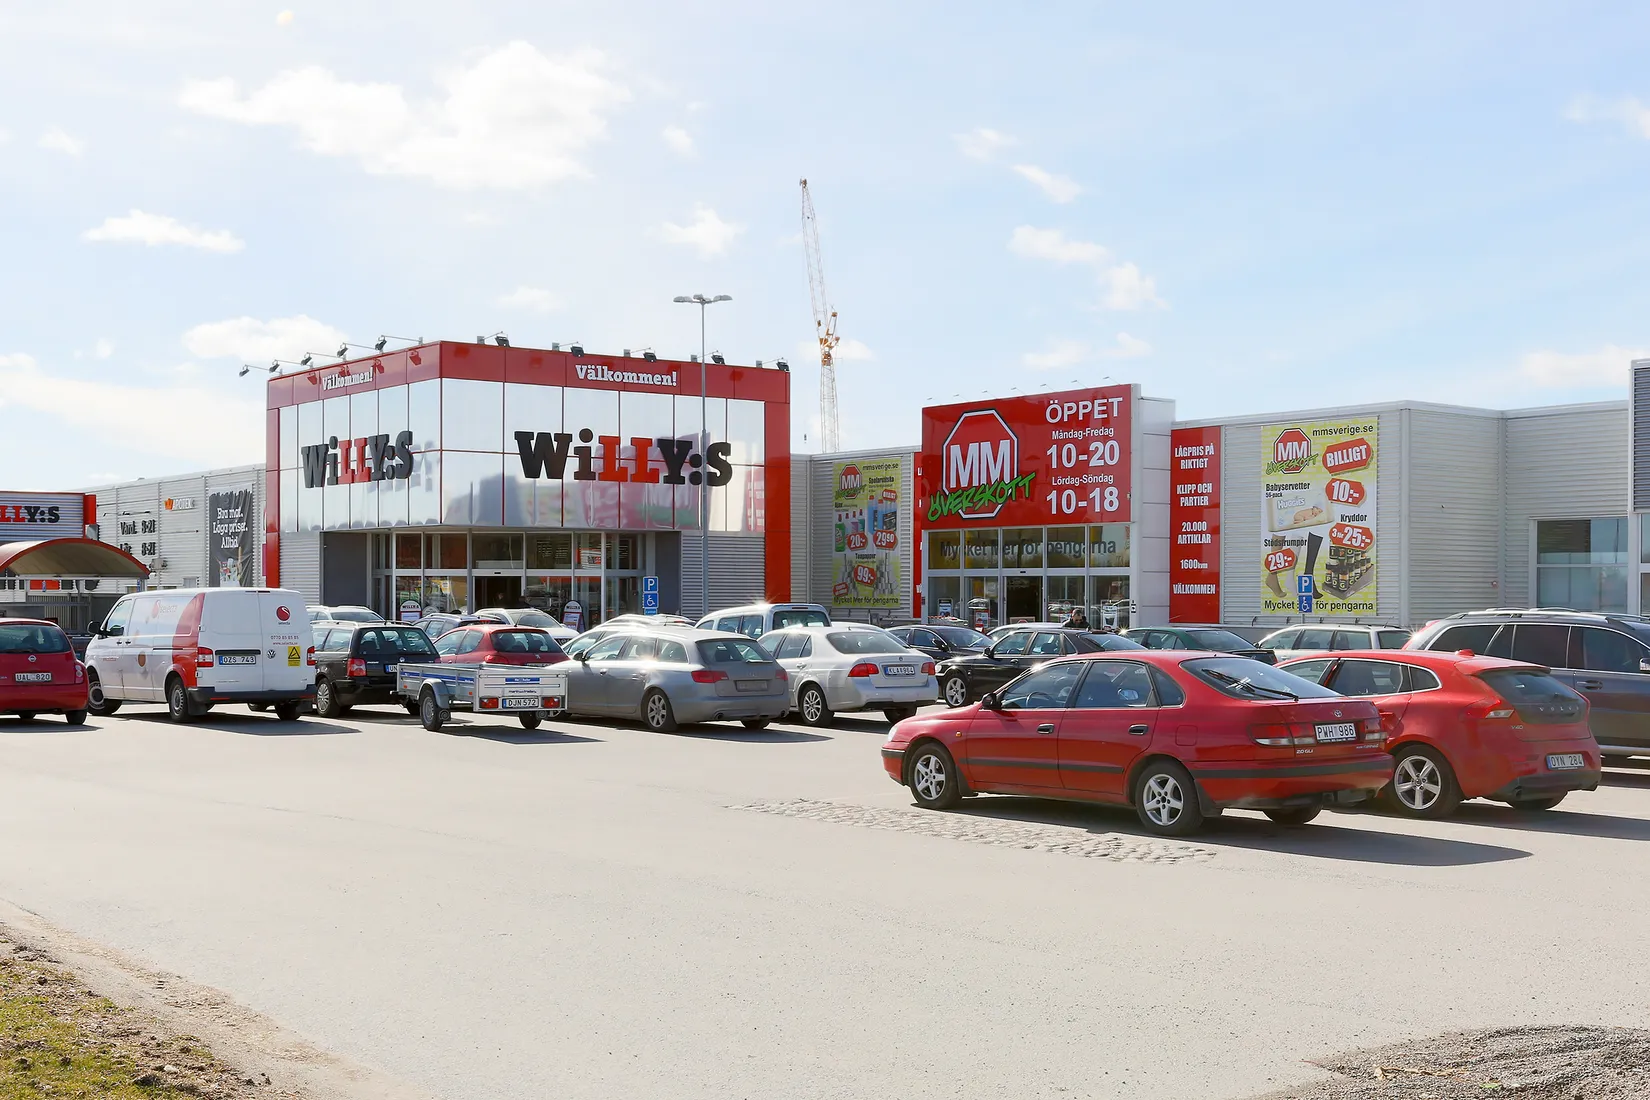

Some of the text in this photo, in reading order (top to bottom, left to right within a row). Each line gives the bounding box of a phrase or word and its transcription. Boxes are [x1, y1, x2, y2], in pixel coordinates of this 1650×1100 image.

[321, 366, 374, 391] Välkommen!
[575, 364, 678, 387] Välkommen!
[1045, 397, 1123, 424] ÖPPET
[1052, 426, 1114, 440] Måndag-Fredag
[1312, 424, 1374, 437] mmsverige.se
[1046, 440, 1120, 469] 10-20
[1174, 442, 1215, 458] LÅGPRIS PÅ
[1277, 441, 1308, 461] MM
[1326, 445, 1367, 467] BILLIGT
[862, 463, 899, 472] mmsverige.se
[950, 439, 1011, 489] MM
[1180, 457, 1209, 470] RIKTIGT
[841, 474, 860, 490] MM
[1052, 474, 1114, 486] Lördag-Söndag
[1265, 482, 1310, 491] Babyservetter
[1176, 483, 1213, 495] KLIPP OCH
[1331, 480, 1360, 503] 10:-
[928, 472, 1036, 522] ÖVERSKOTT
[1046, 487, 1120, 515] 10-18
[1180, 495, 1209, 507] PARTIER
[0, 505, 60, 523] LLY:S
[217, 506, 244, 519] Bra mat.
[1340, 513, 1367, 523] Kryddor
[120, 519, 156, 535] Vard. 8-21
[212, 520, 249, 536] Låga priser.
[1182, 521, 1207, 533] 20.000
[1177, 532, 1212, 545] ARTIKLAR
[1263, 538, 1307, 548] Stödstrumpor
[1332, 528, 1337, 538] 3
[1343, 526, 1371, 548] 25:-
[141, 542, 156, 556] 8-21
[1267, 552, 1293, 571] 29:-
[648, 579, 655, 590] P
[1172, 583, 1216, 595] VÄLKOMMEN
[1302, 577, 1310, 592] P
[872, 597, 899, 605] pengarna
[1264, 600, 1295, 610] Mycket
[1315, 601, 1329, 610] för
[1330, 602, 1374, 613] pengarna
[223, 655, 255, 663] OZS 743
[16, 673, 31, 681] UAL
[508, 699, 522, 707] DJN
[1317, 724, 1355, 739] PWH 986
[1568, 754, 1583, 766] 284
